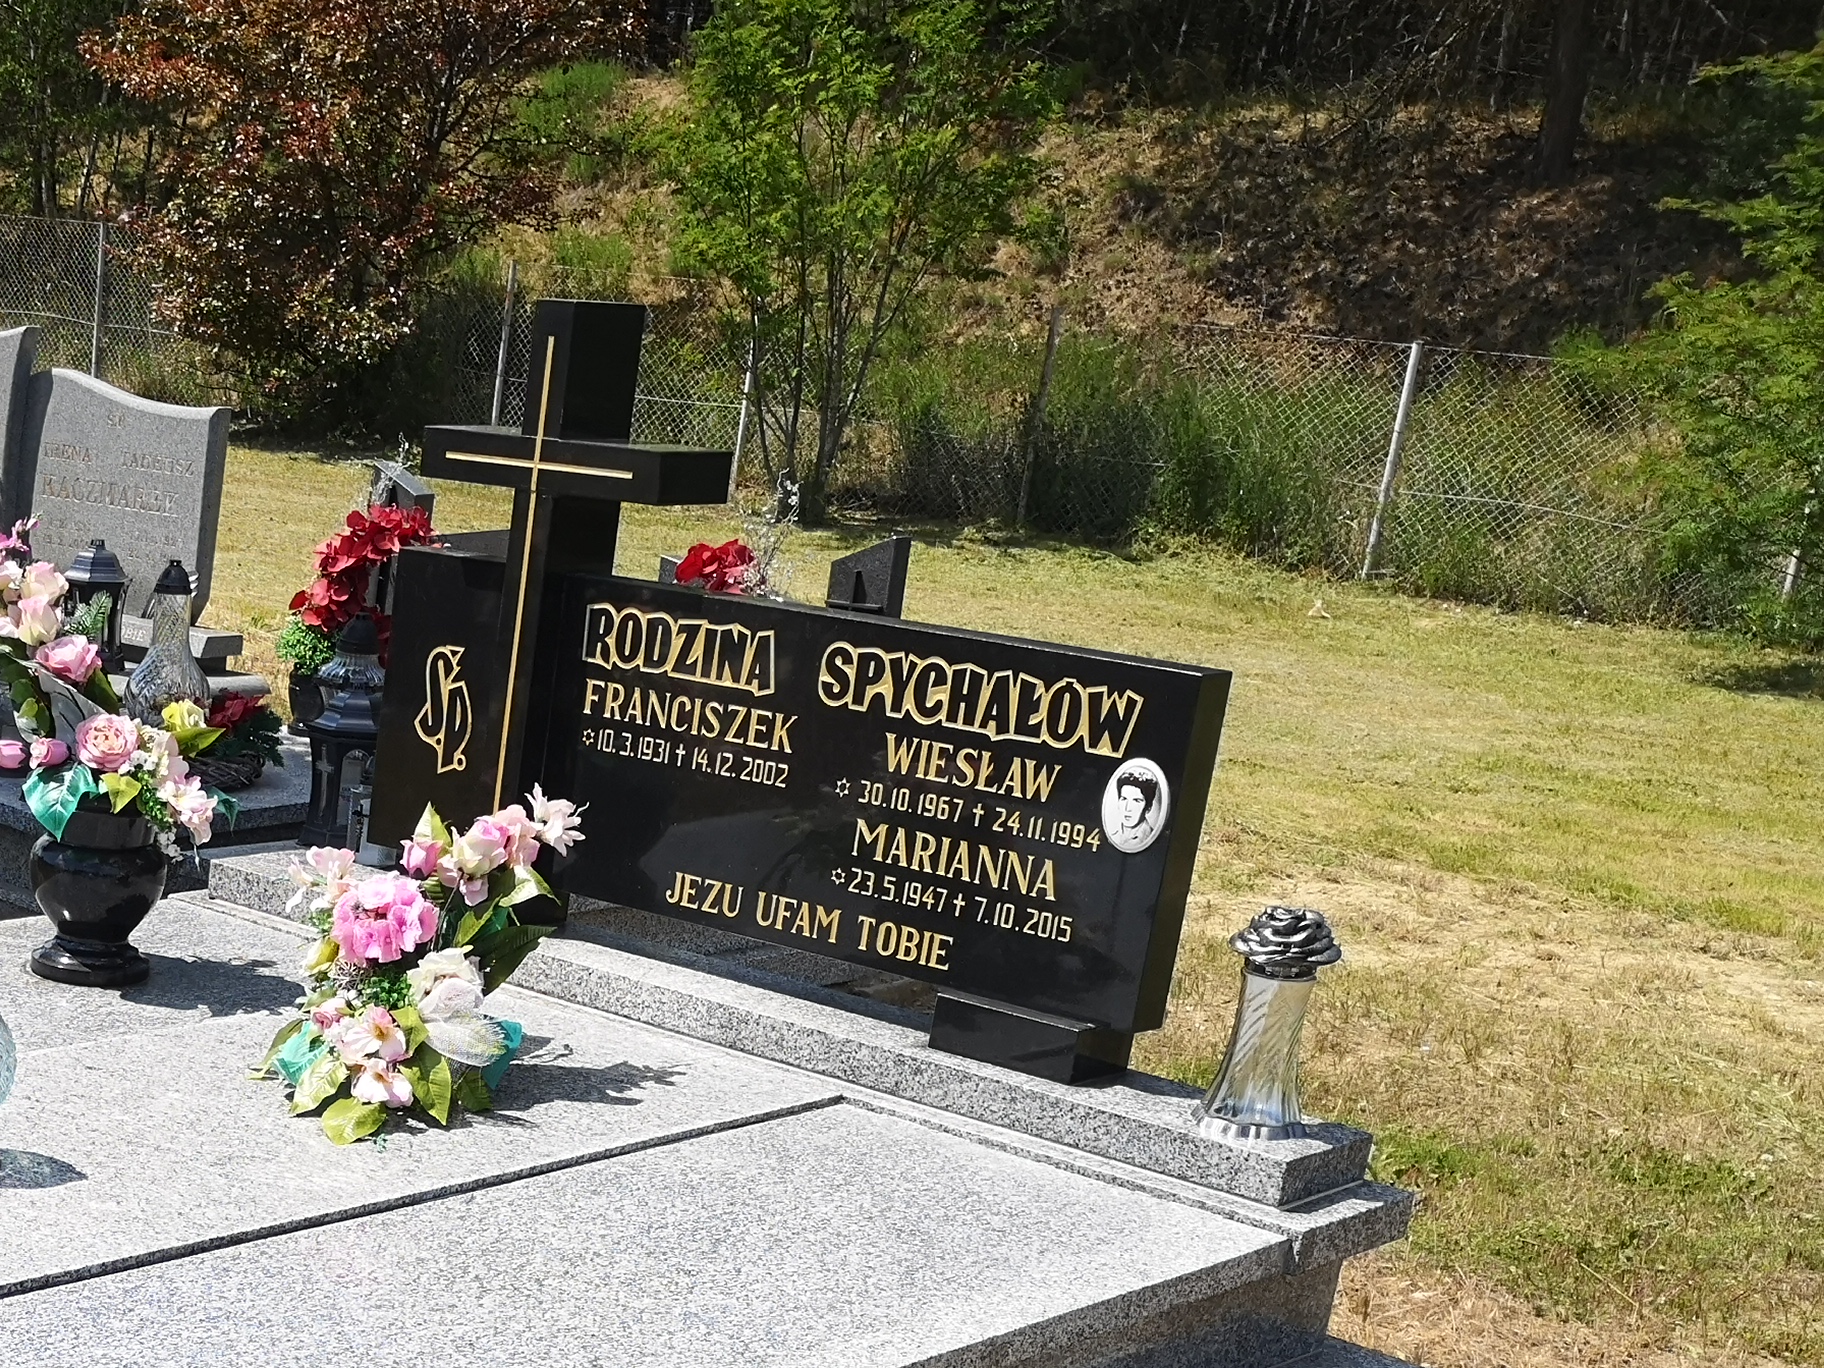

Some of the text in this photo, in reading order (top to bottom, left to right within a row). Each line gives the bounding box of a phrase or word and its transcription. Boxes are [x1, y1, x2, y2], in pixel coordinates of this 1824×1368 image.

[43, 441, 195, 478] IRENA TADEUSZ
[582, 602, 1144, 758] RODZINA SPYCHAŁÓW
[582, 677, 799, 754] FRANCISZEK
[884, 731, 1063, 803] WIESŁAW
[857, 779, 1101, 853] 30.10.1967 24.11.1994
[851, 818, 1057, 901] MARIANNA
[664, 870, 955, 971] JEZU UFAM TOBIE
[847, 867, 1075, 944] 23.5.1947 7.10.2015
